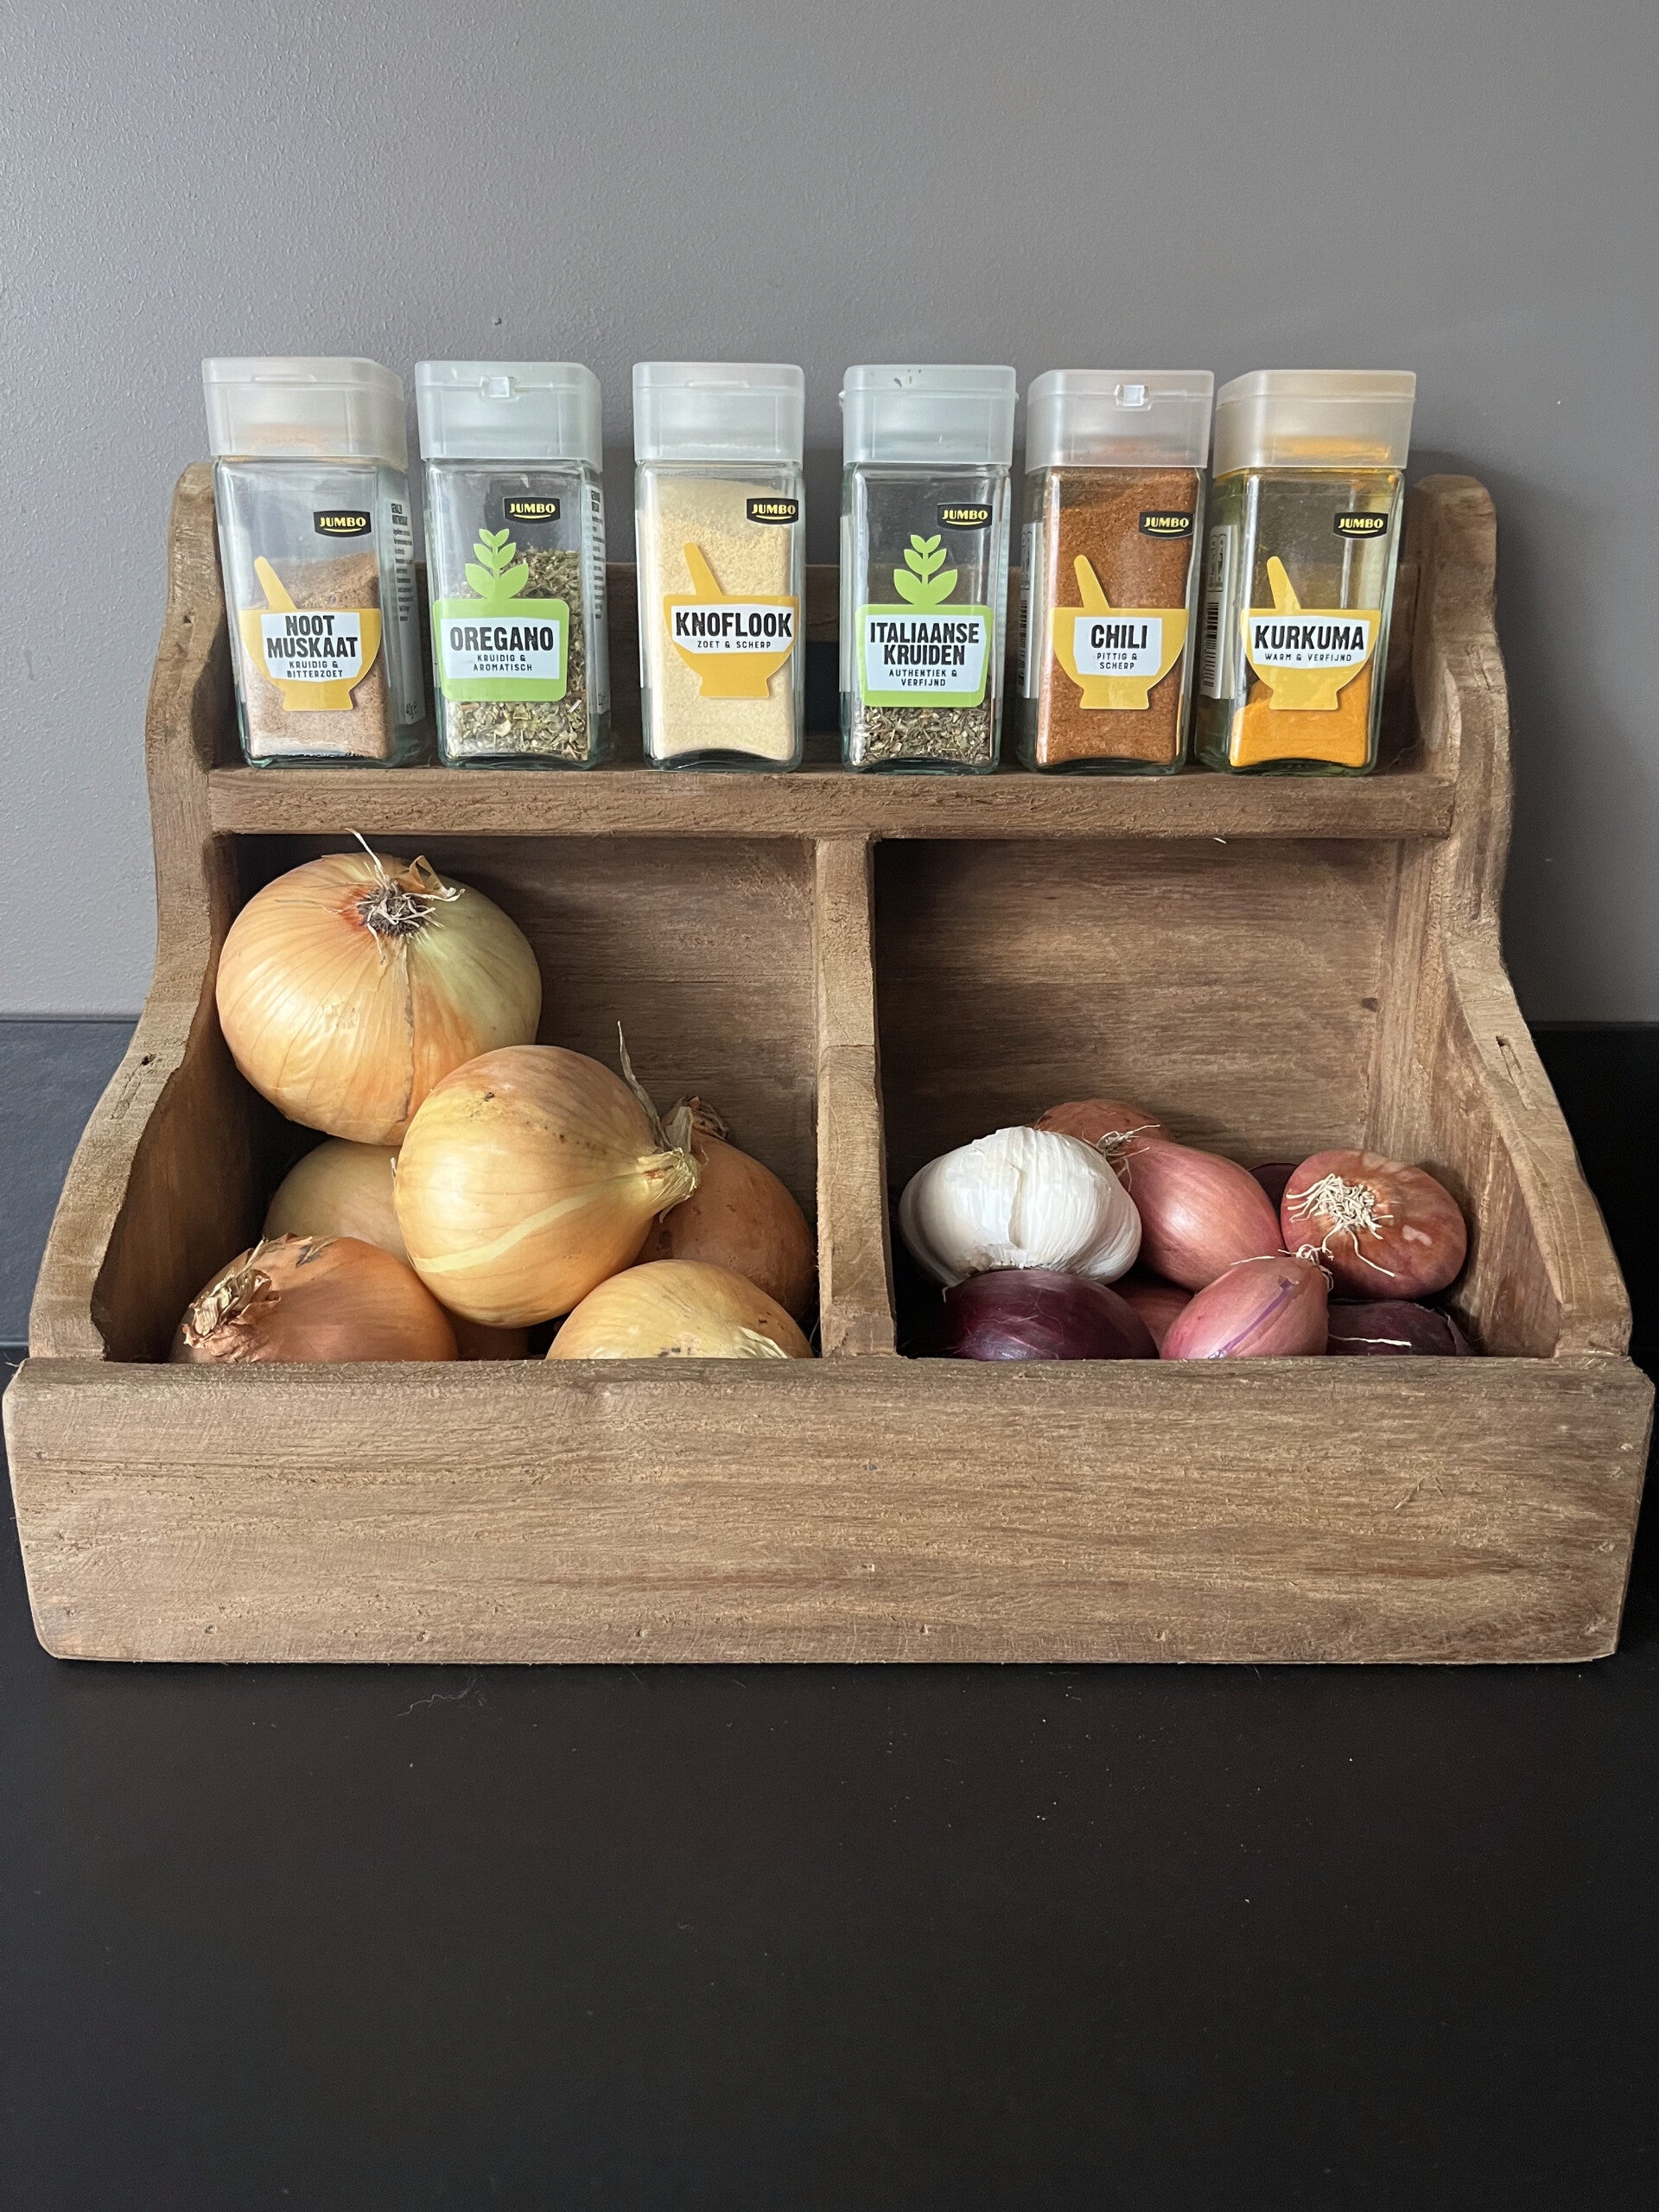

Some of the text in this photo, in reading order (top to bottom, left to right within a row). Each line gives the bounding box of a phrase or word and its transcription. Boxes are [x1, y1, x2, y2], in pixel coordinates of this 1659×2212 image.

[509, 503, 556, 513] JUMBO
[752, 504, 796, 515] JUMBO
[942, 510, 988, 520] JUMBO
[320, 517, 366, 527] JUMBO
[1144, 517, 1189, 528] JUMBO
[1338, 518, 1383, 529] JUMBO
[285, 615, 334, 636] NOOT
[676, 612, 792, 638] KNOFLOOK
[870, 622, 979, 644] ITALIAANSE
[1090, 624, 1147, 649] CHILI
[1255, 625, 1364, 651] KURKUMA
[449, 626, 554, 652] OREGANO
[736, 640, 772, 649] SCHERP
[267, 637, 358, 658] MUSKAAT
[884, 645, 965, 665] KRUIDEN
[1307, 653, 1352, 662] VERFIJND
[289, 660, 327, 669] KRUIDIG
[287, 670, 343, 678] BITTERZOET
[888, 669, 946, 677] AUTHENTIEK
[901, 678, 946, 687] VERFIJND
